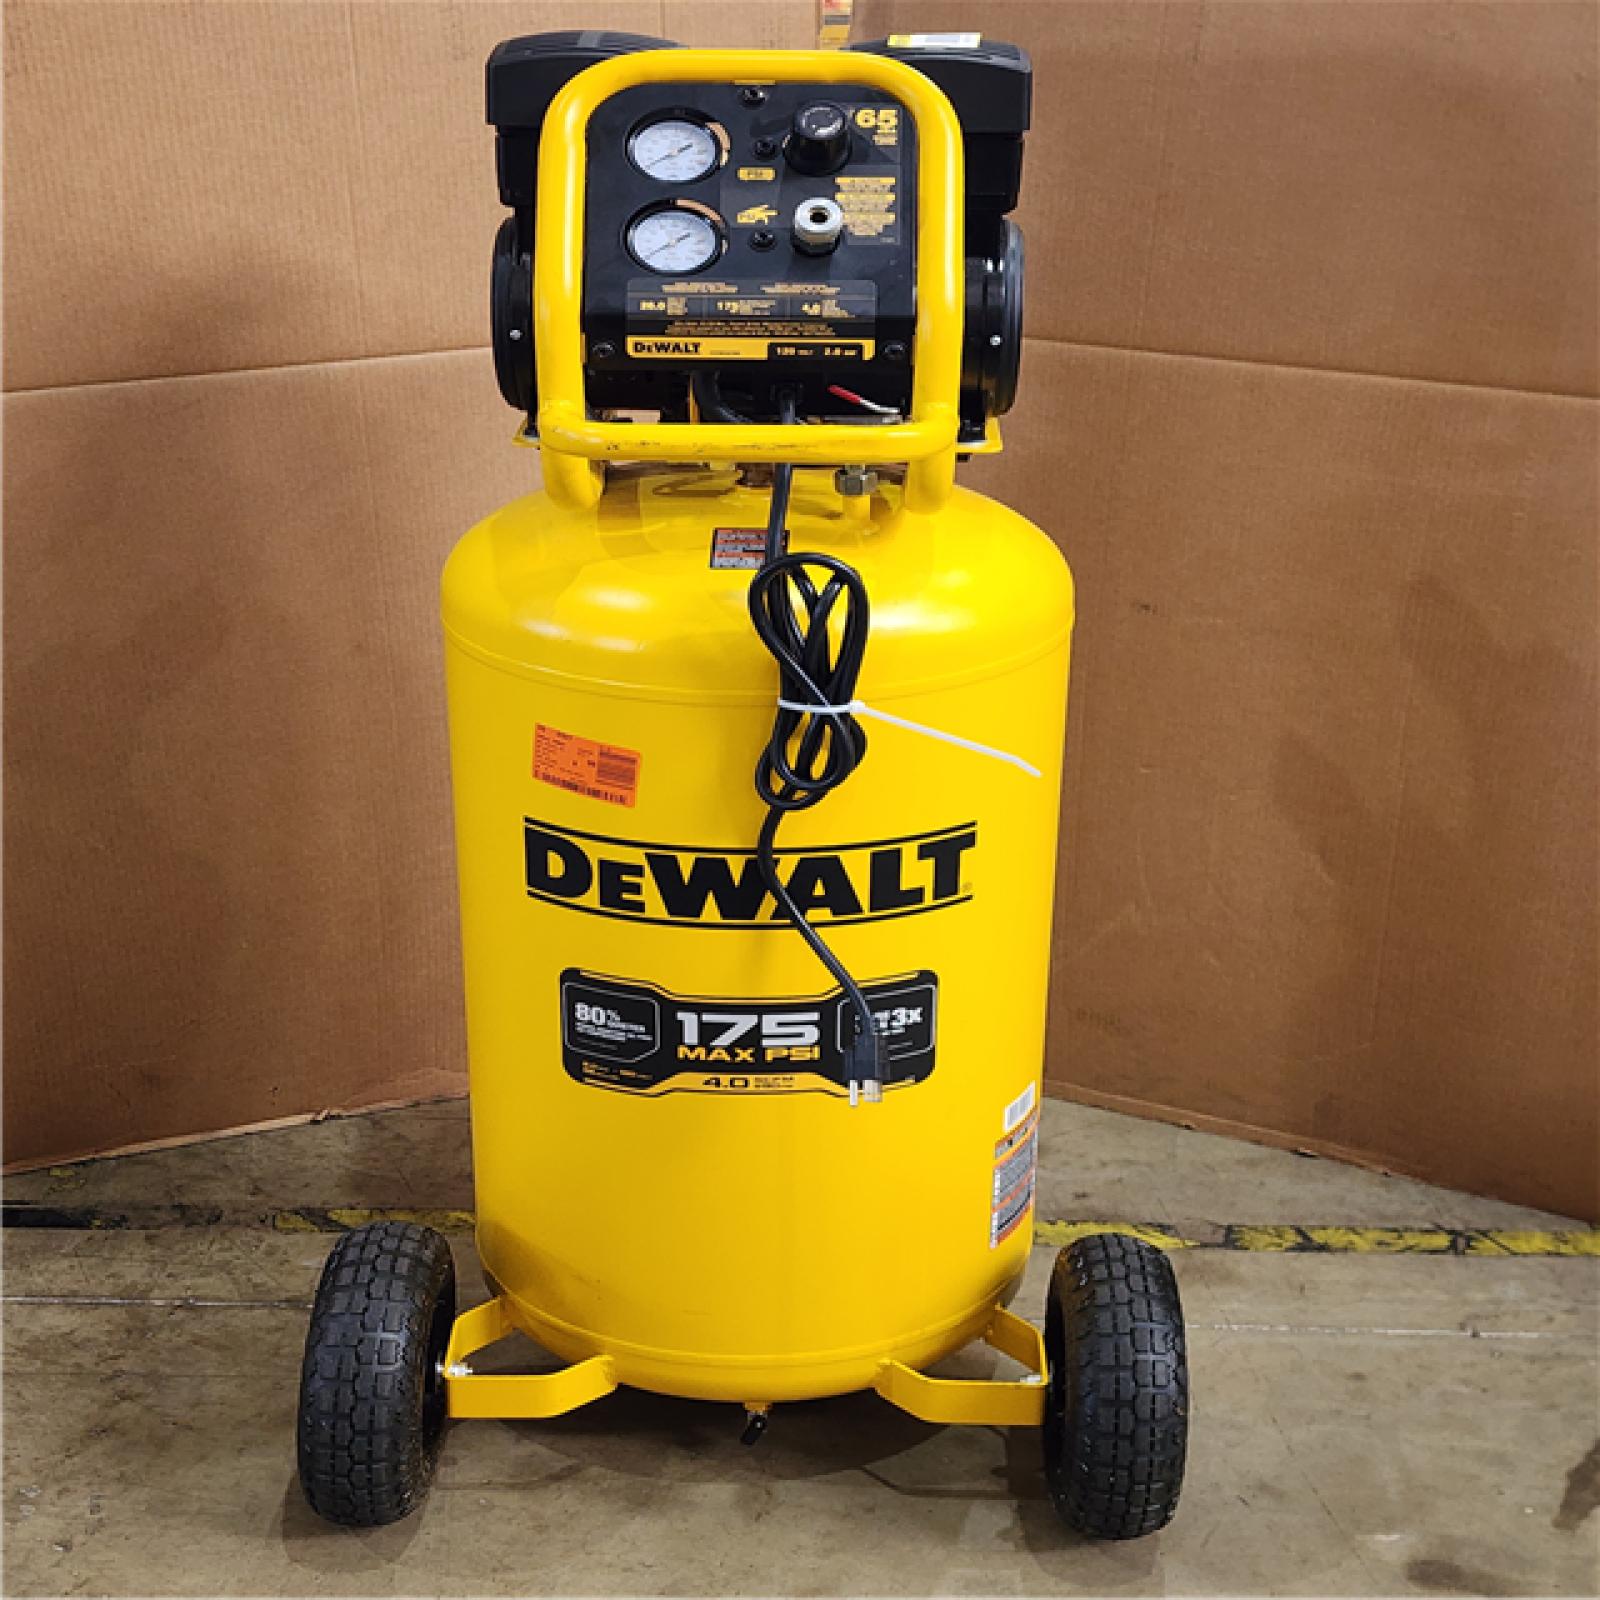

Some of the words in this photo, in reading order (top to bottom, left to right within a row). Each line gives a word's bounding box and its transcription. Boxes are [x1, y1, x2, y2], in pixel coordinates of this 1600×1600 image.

[677, 1012, 819, 1045] 175
[677, 1045, 755, 1062] MAX
[764, 1045, 819, 1062] PSI
[703, 1077, 749, 1088] 4.0
